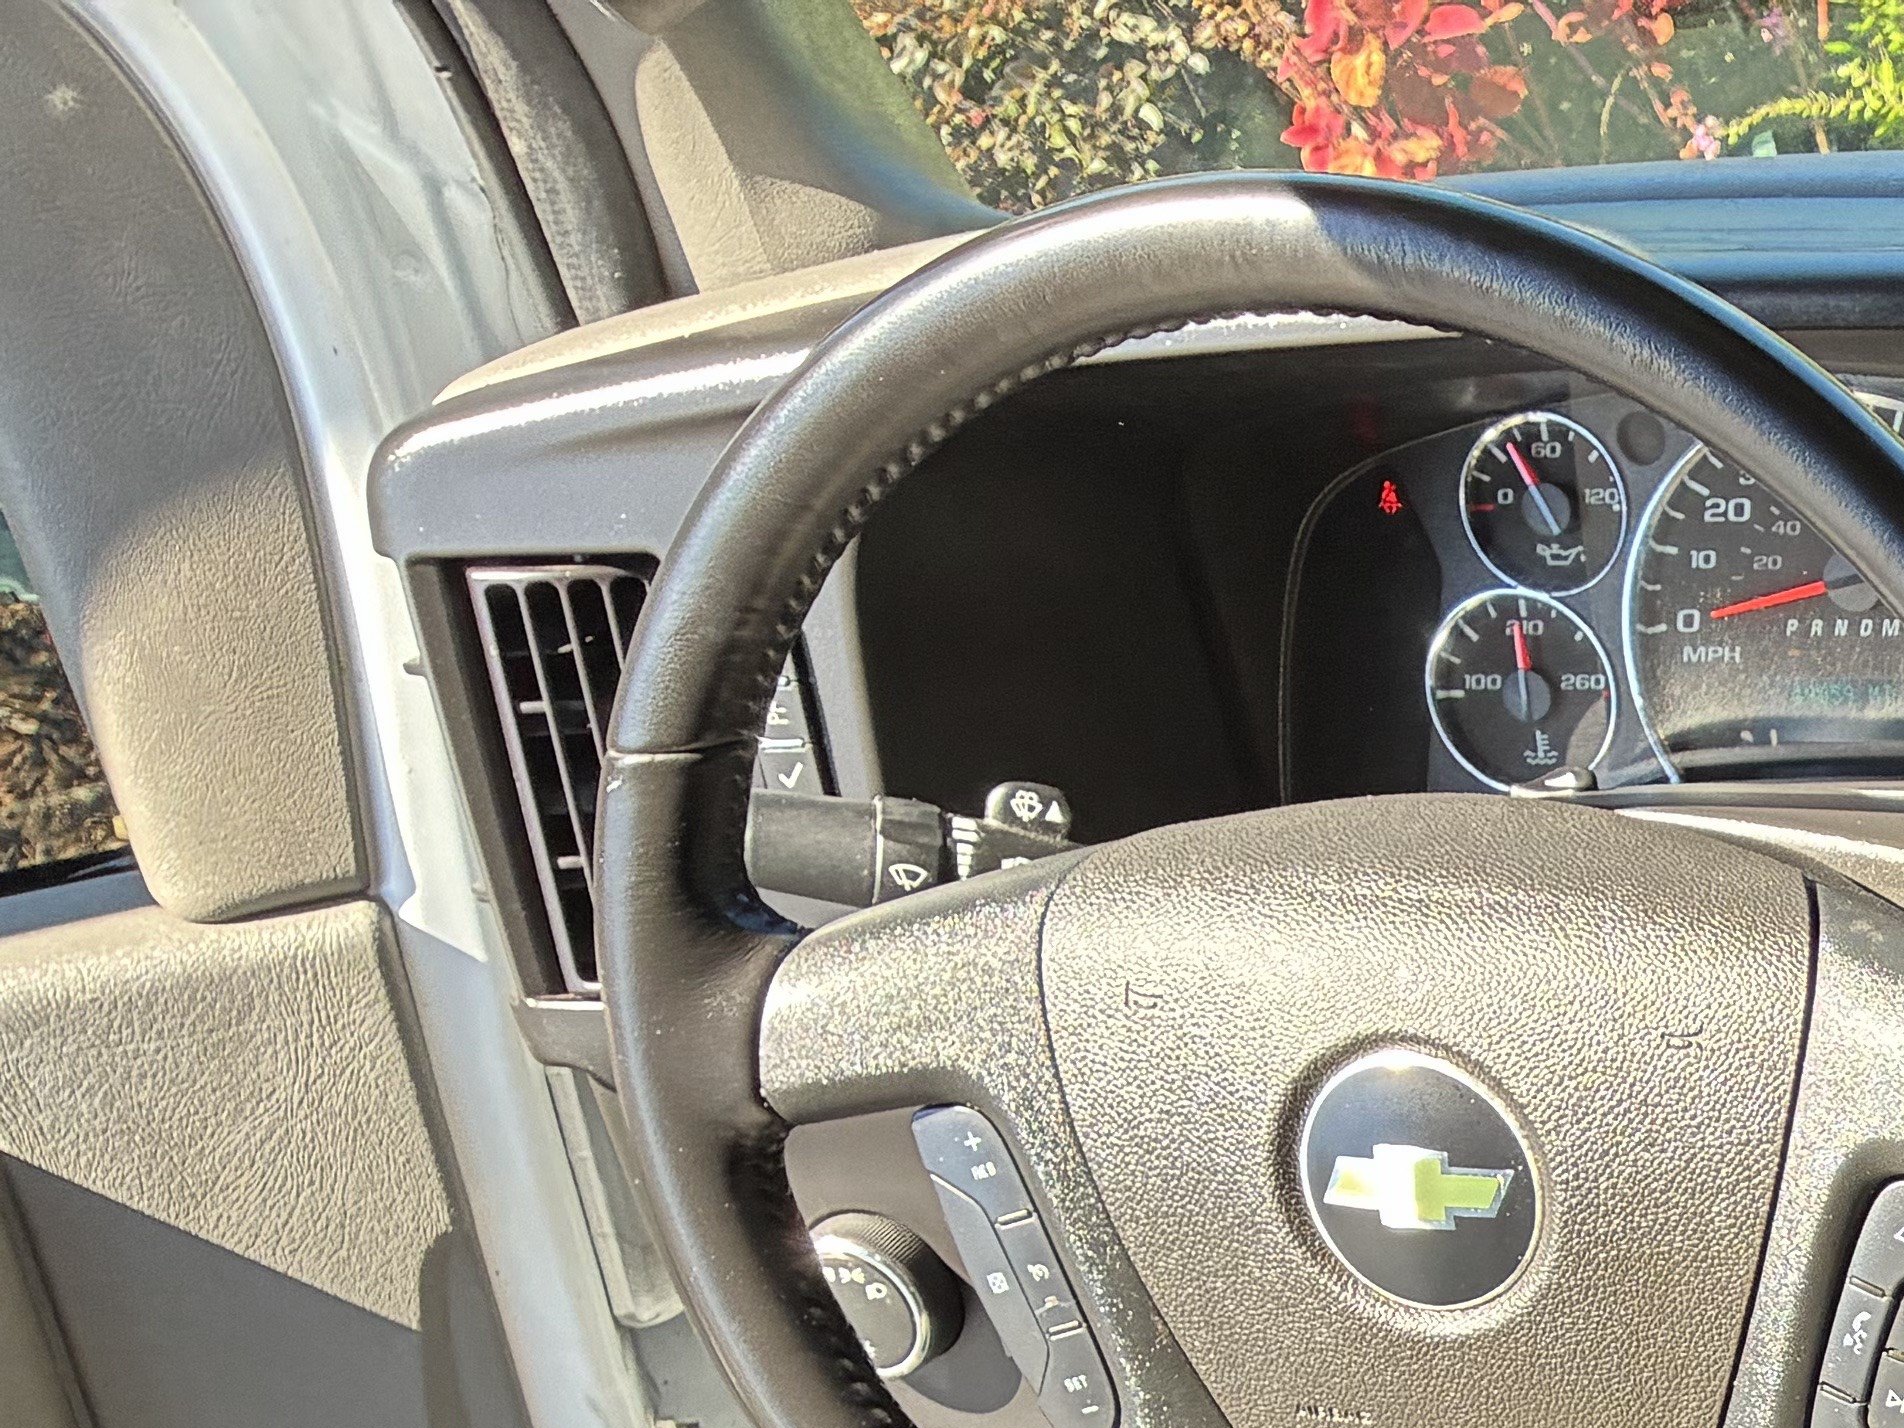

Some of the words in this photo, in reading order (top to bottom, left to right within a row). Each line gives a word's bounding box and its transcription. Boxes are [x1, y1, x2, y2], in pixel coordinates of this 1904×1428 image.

[1531, 441, 1562, 459] 60
[1497, 487, 1514, 505] 0
[1584, 487, 1619, 505] 120
[1703, 497, 1751, 523] 20
[1771, 520, 1801, 536] 40
[1690, 550, 1717, 569] 10
[1753, 554, 1782, 570] 20
[1676, 608, 1701, 633] 0
[1682, 645, 1742, 664] MPH
[1464, 673, 1502, 690] 100
[1560, 673, 1606, 691] 260
